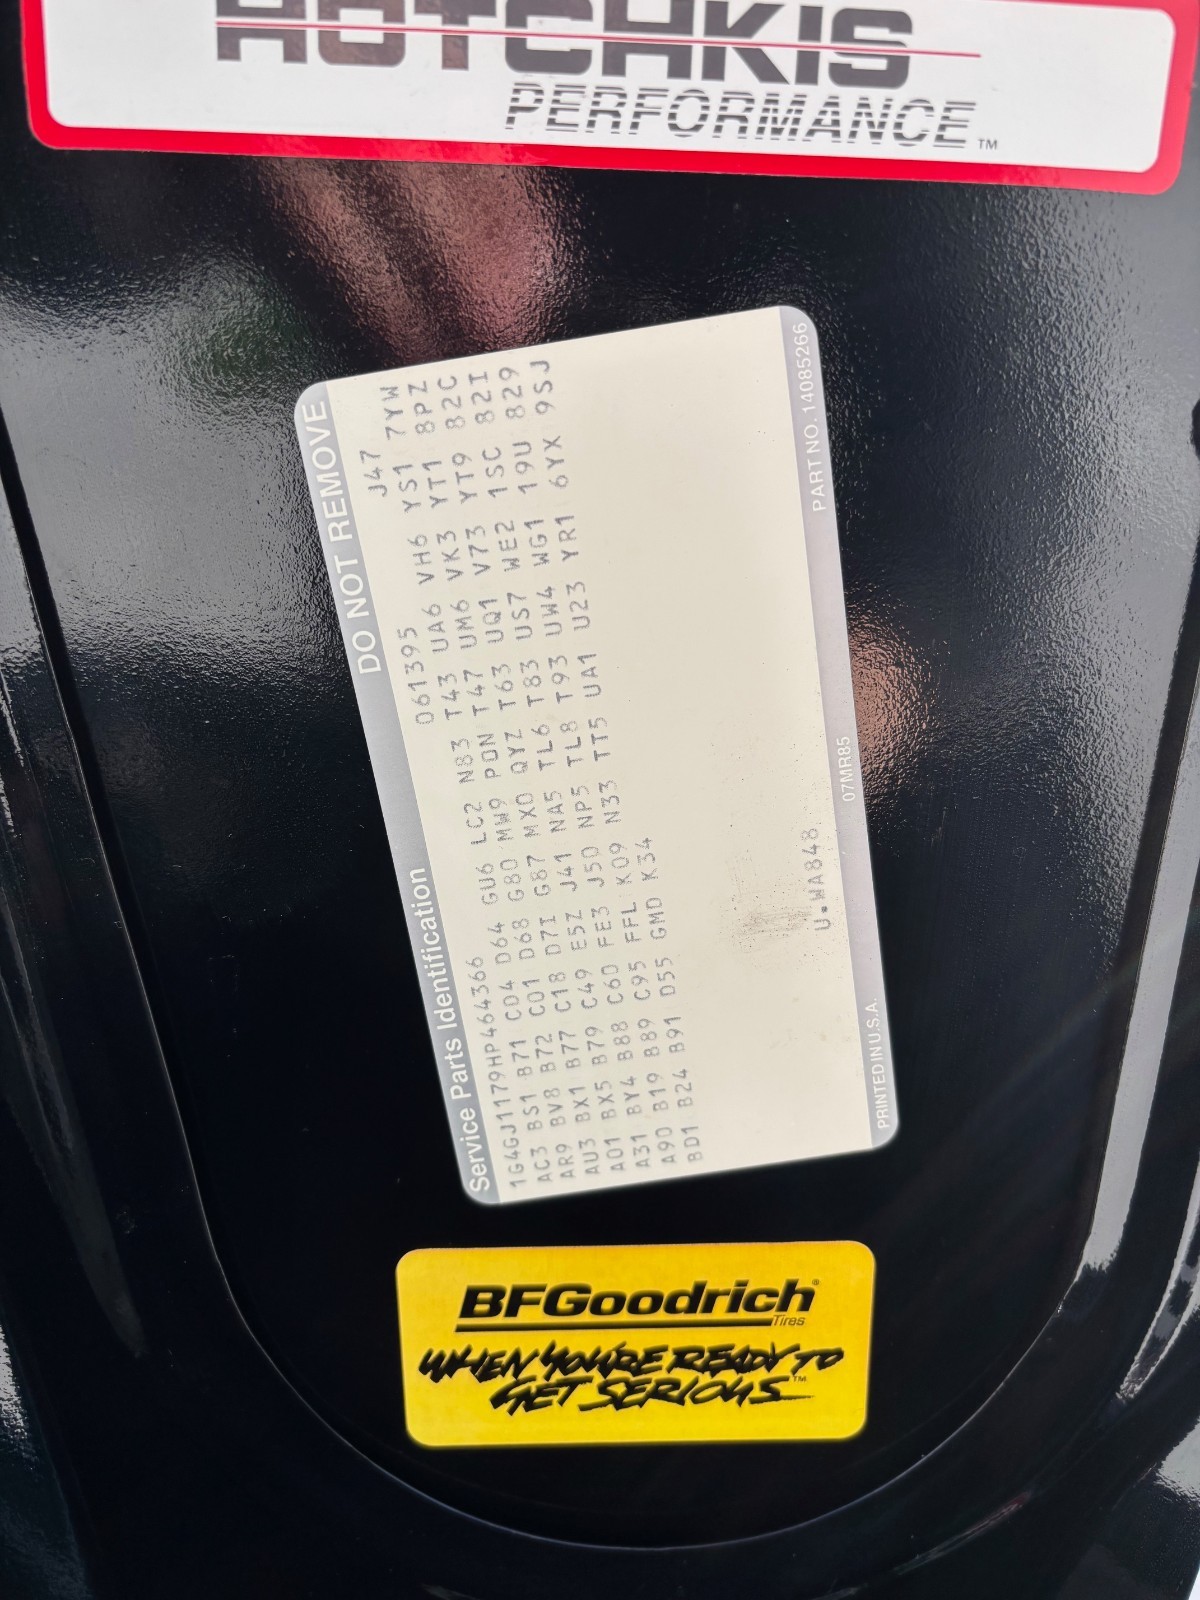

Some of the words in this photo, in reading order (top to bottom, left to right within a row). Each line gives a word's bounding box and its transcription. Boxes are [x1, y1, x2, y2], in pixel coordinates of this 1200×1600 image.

[215, 0, 913, 89] HOTCHKIS
[504, 82, 977, 148] PERFORMANCE
[528, 359, 554, 415] 9SJ
[792, 322, 815, 412] 14085266
[378, 385, 406, 440] 7YW
[406, 379, 435, 435] 8PZ
[436, 374, 465, 429] 82C
[497, 366, 525, 419] 829
[803, 418, 820, 453] NO.
[299, 400, 352, 542] REMOVE
[358, 449, 388, 497] J47
[420, 459, 448, 509] YT1
[450, 451, 478, 504] YT9
[480, 446, 508, 498] 1SC
[511, 440, 538, 494] 19U
[541, 434, 568, 488] 6YX
[391, 463, 421, 513] YS1
[807, 459, 826, 511] PART
[406, 533, 435, 585] VH6
[435, 529, 464, 581] VK3
[464, 524, 491, 576] V73
[493, 519, 520, 572] WE2
[523, 518, 550, 567] WG1
[553, 514, 579, 562] YR1
[332, 554, 369, 618] NOT
[565, 580, 591, 631] U23
[421, 603, 449, 653] UA6
[449, 598, 477, 649] UM6
[477, 598, 504, 643] UQ1
[505, 591, 533, 640] US7
[535, 585, 562, 637] UW4
[351, 630, 381, 674] DO
[396, 626, 434, 724] 061395
[576, 652, 602, 698] UA1
[436, 672, 462, 721] T43
[462, 668, 489, 717] T47
[490, 663, 516, 711] T63
[518, 658, 544, 707] T83
[547, 654, 573, 704] T93
[449, 737, 474, 784] N83
[503, 728, 528, 774] QYZ
[530, 723, 555, 771] TL6
[559, 720, 583, 767] TL8
[587, 716, 610, 762] TT5
[836, 736, 855, 801] 07MR85
[462, 801, 487, 845] LC2
[487, 797, 513, 842] MW9
[542, 790, 566, 833] NA5
[569, 785, 594, 829] NP5
[597, 779, 621, 824] N33
[525, 854, 551, 897] G87
[552, 852, 578, 892] J41
[634, 837, 658, 881] K34
[474, 862, 498, 905] GU6
[486, 921, 511, 964] D64
[511, 917, 535, 960] D68
[564, 909, 587, 951] E5Z
[590, 905, 614, 948] FE3
[620, 901, 641, 943] FFL
[409, 868, 456, 1029] Identification
[547, 971, 571, 1013] C18
[573, 968, 598, 1009] C49
[627, 960, 651, 1001] C95
[653, 956, 676, 997] D55
[610, 1020, 633, 1061] B88
[636, 1017, 660, 1057] B89
[662, 1016, 685, 1053] B91
[865, 998, 881, 1043] U.S.A.
[444, 1038, 471, 1099] Parts
[508, 1039, 533, 1077] B71
[534, 1032, 556, 1073] B72
[557, 1029, 581, 1069] B77
[584, 1025, 607, 1066] B79
[869, 1046, 883, 1061] IN
[465, 956, 527, 1188] 1G4GJ1179HP464366
[645, 1072, 668, 1112] B19
[671, 1068, 693, 1108] B24
[518, 1093, 543, 1131] BS1
[542, 1087, 566, 1127] BV8
[567, 1086, 591, 1123] BX1
[593, 1080, 616, 1120] BX5
[619, 1075, 642, 1116] BY4
[871, 1063, 890, 1129] PRINTED
[459, 1108, 489, 1191] Service
[529, 1145, 552, 1182] AC3
[554, 1143, 575, 1178] AR9
[577, 1137, 600, 1175] AU3
[629, 1133, 650, 1168] A31
[458, 1279, 816, 1318] BFGoodrich
[773, 1314, 806, 1327] Tires
[418, 1344, 540, 1384] WHEN
[665, 1341, 801, 1378] READY
[789, 1347, 844, 1375] TO
[489, 1374, 594, 1416] GET
[578, 1375, 815, 1411] SERIOUS
